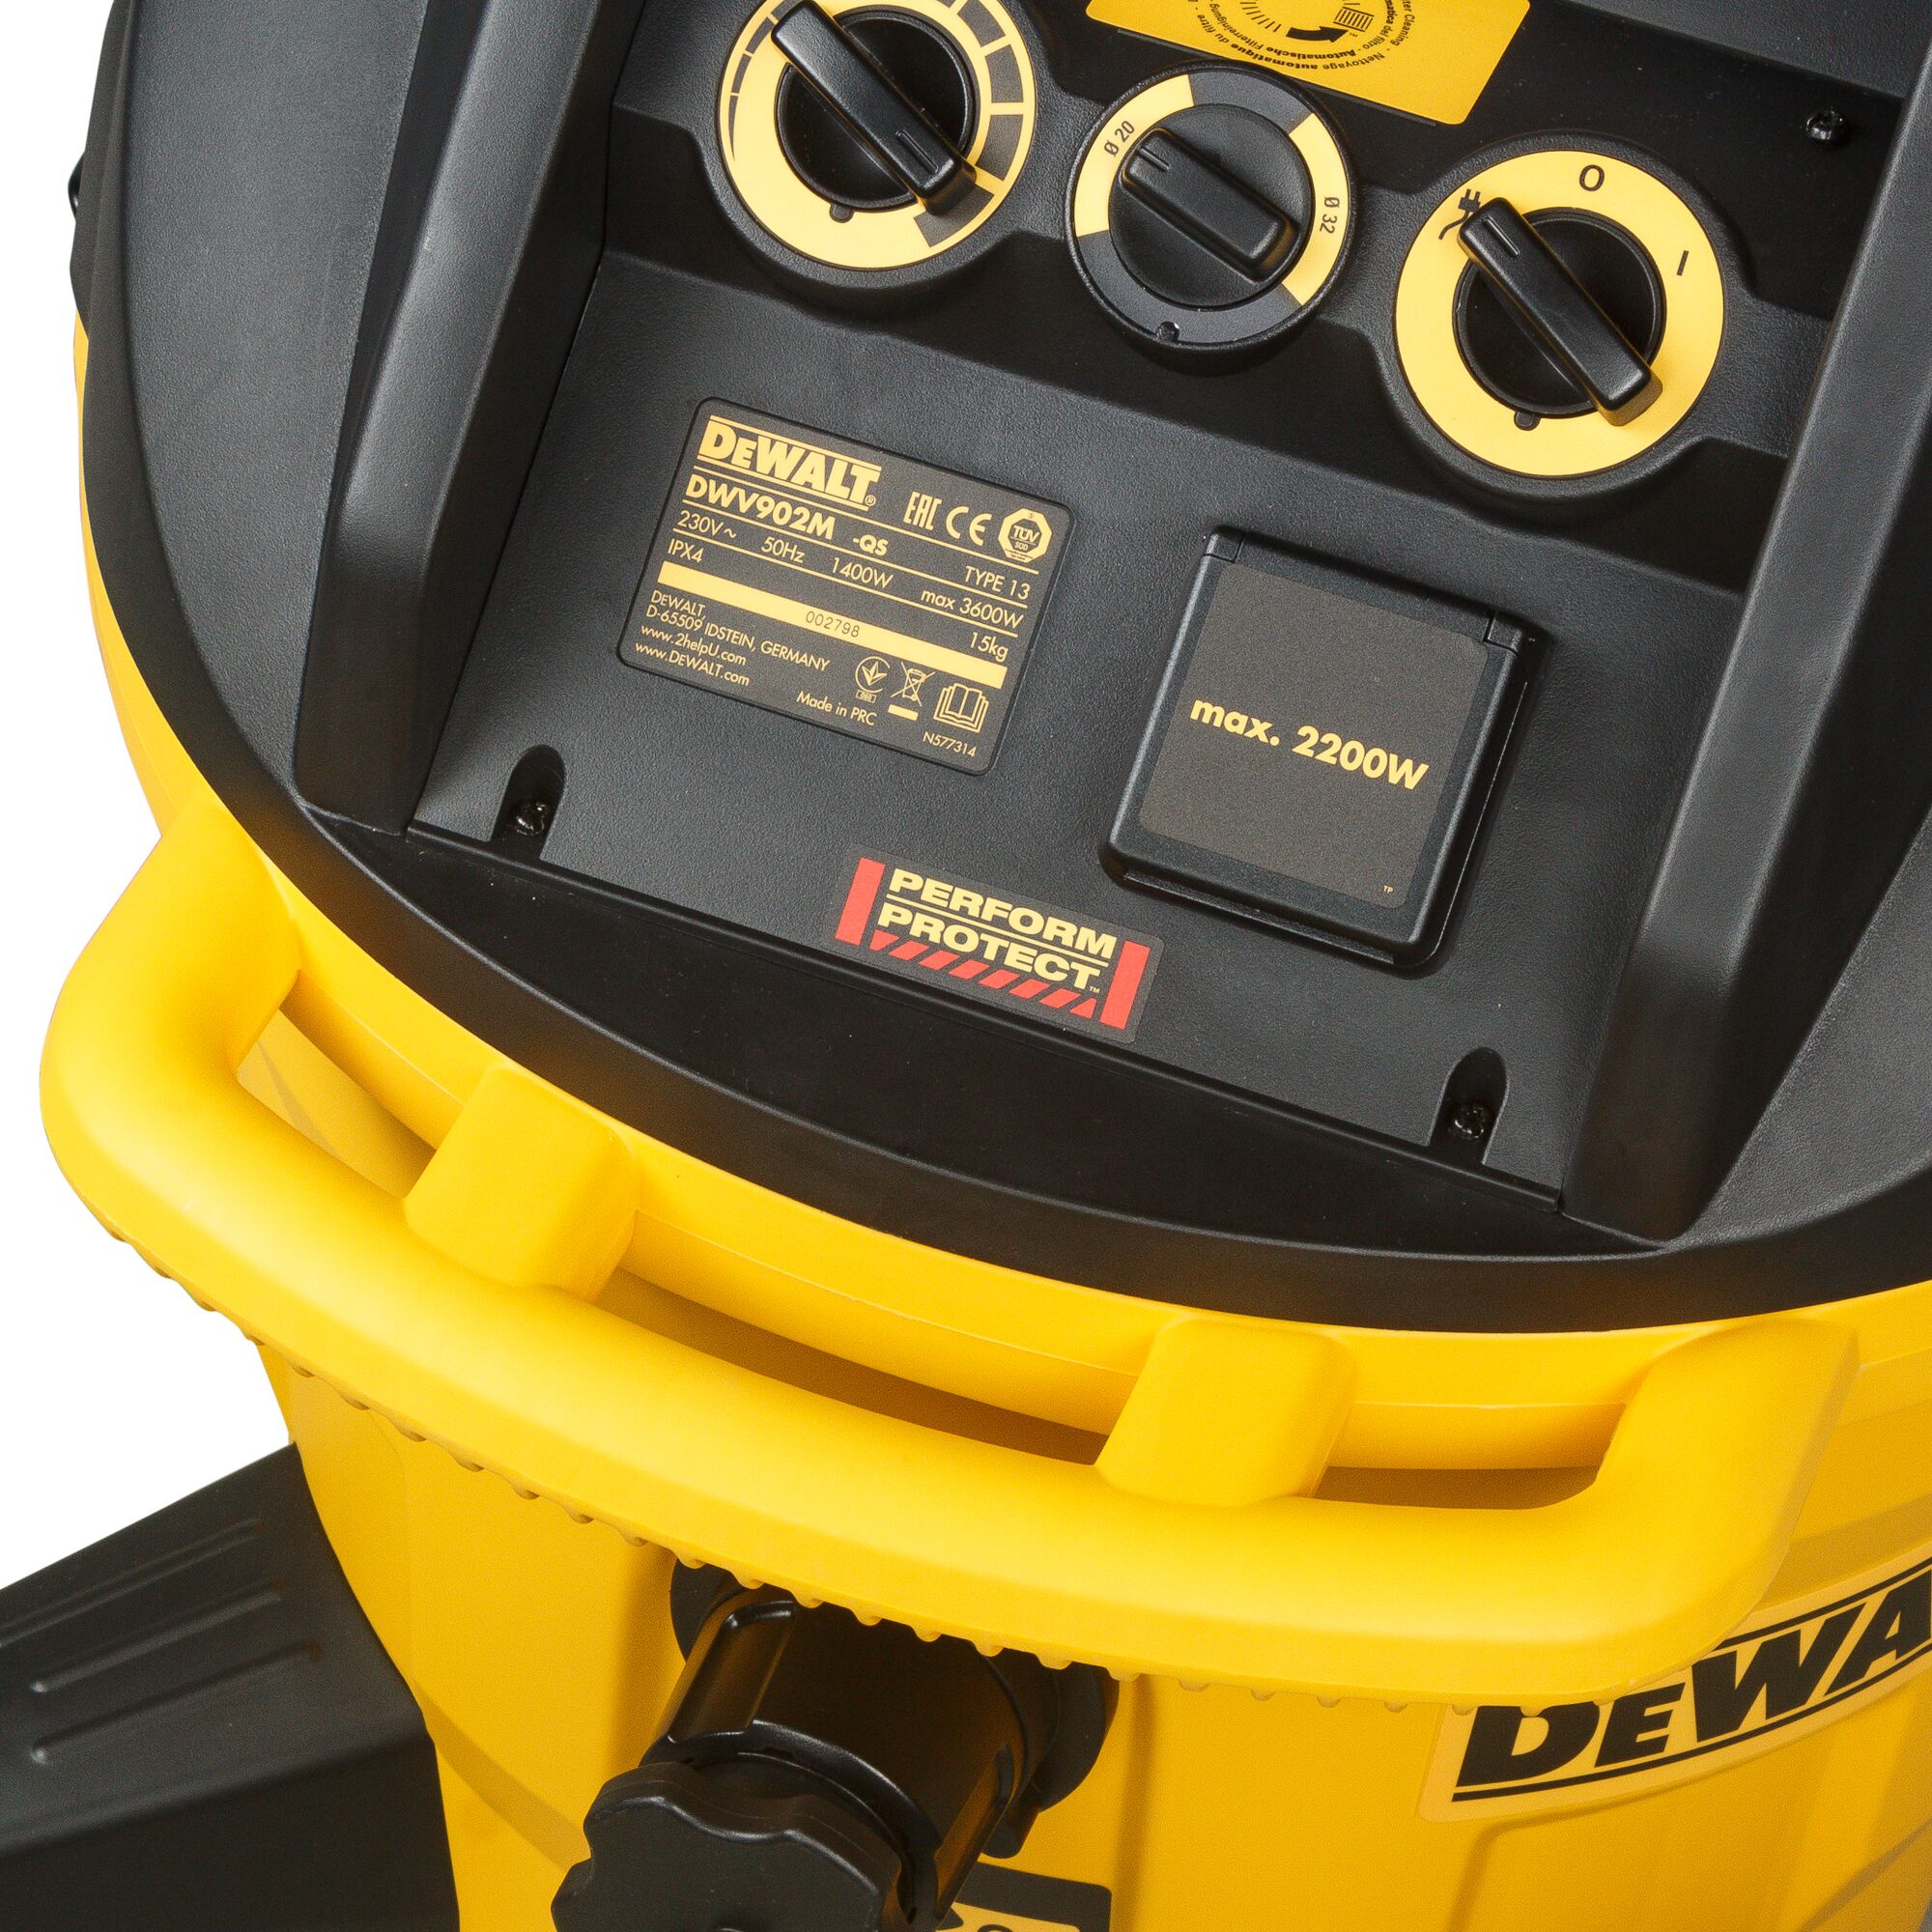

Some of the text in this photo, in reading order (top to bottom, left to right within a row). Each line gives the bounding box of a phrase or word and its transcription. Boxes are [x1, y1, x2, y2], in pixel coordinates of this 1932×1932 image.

[1197, 14, 1385, 70] Nettoyage automatique du filtre
[1209, 3, 1356, 59] Automatische Filterreinigung
[1362, 35, 1385, 49] filtro
[1379, 25, 1393, 38] del
[1390, 14, 1415, 45] Cleaning
[1114, 120, 1136, 144] 20
[1320, 213, 1338, 235] 32
[697, 419, 882, 504] DEWALT
[685, 473, 890, 556] DWV902M -QS
[668, 538, 704, 563] IPX4
[761, 536, 806, 563] 50Hz
[832, 557, 894, 589] 1400W
[921, 590, 956, 611] max
[959, 597, 1024, 629] 3600W
[965, 565, 1031, 600] TYPE 13
[645, 605, 831, 671] D-65509 IDSTEIN, GERMANY
[806, 611, 861, 638] 002798
[635, 642, 751, 686] www.DEWALT.com
[640, 626, 747, 666] www.2helpU.com
[970, 632, 1009, 663] 15kg
[796, 691, 833, 712] Made
[835, 701, 848, 718] in
[850, 706, 877, 725] PRC
[923, 731, 978, 757] N577314
[1189, 699, 1430, 790] max. 2200W
[889, 868, 1118, 959] PERFORM
[877, 902, 1100, 990] PROTECT
